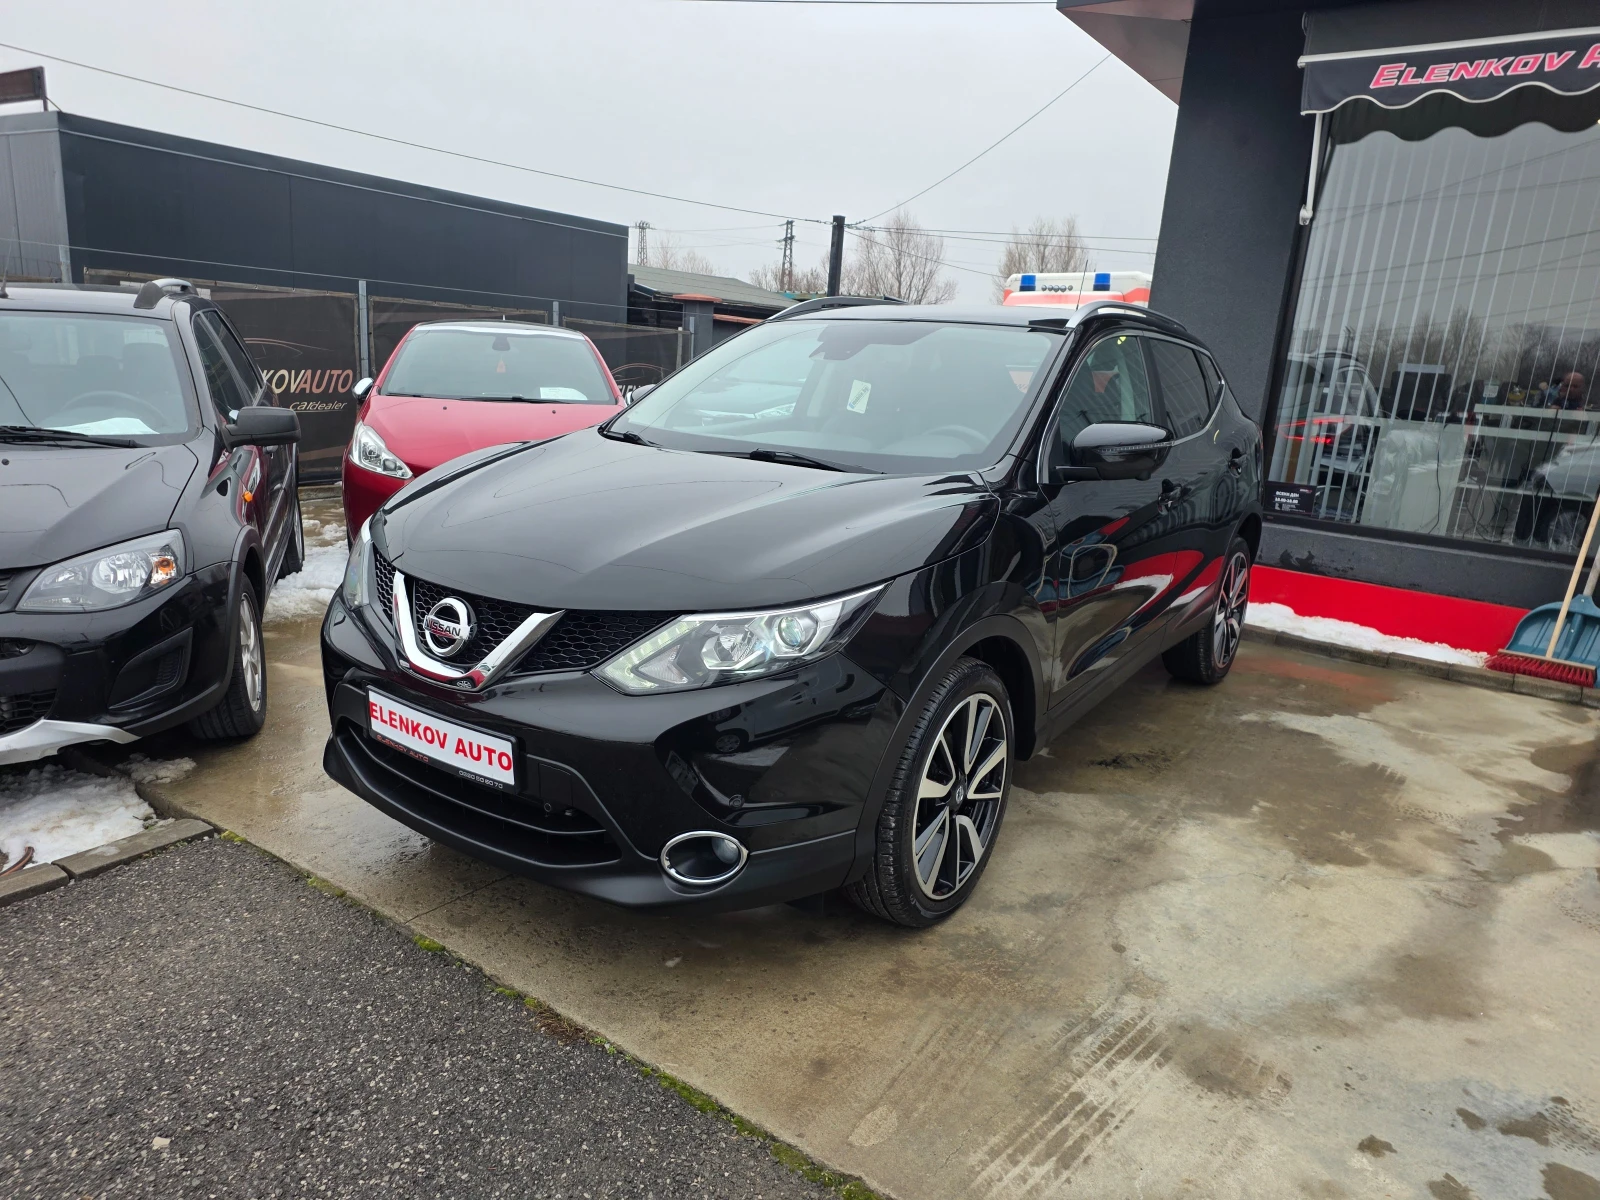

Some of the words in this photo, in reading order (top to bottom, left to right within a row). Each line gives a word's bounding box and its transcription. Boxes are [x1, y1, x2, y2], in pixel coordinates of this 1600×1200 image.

[1369, 50, 1577, 89] ELENKOV
[424, 617, 462, 637] NISSAN
[369, 701, 448, 749] ELENKOV
[455, 737, 513, 772] AUTO
[409, 750, 429, 763] AUTO
